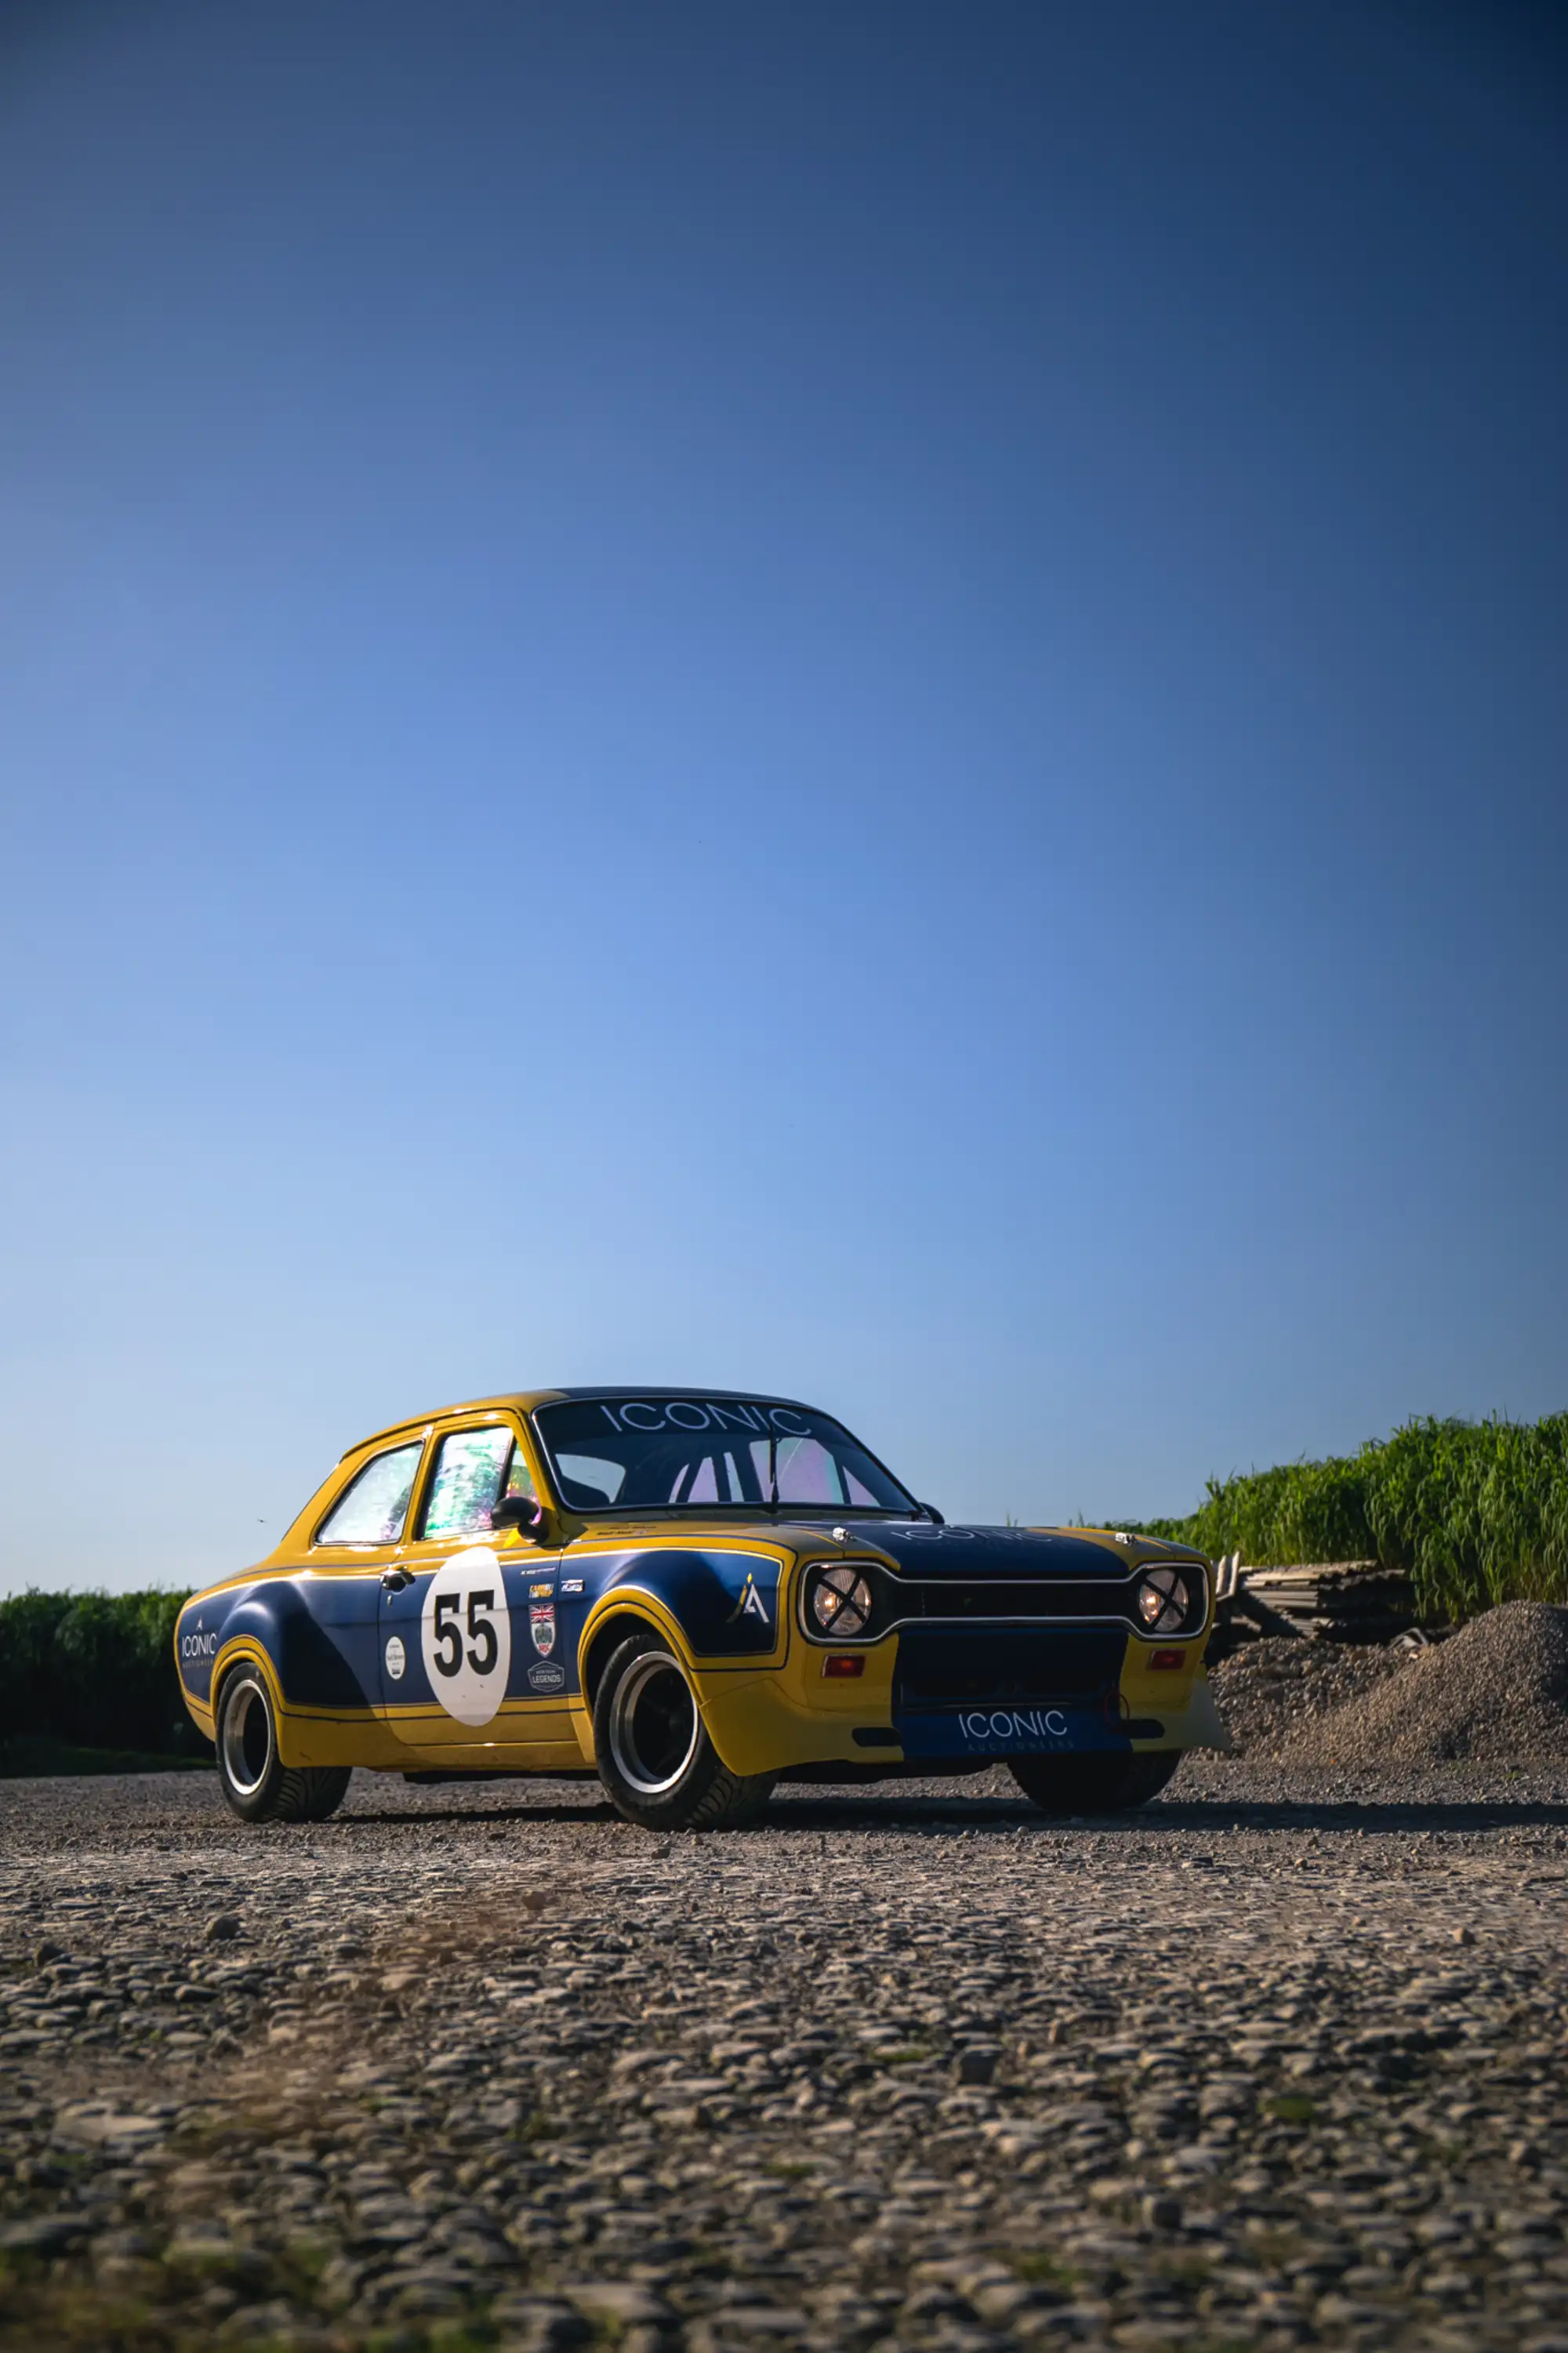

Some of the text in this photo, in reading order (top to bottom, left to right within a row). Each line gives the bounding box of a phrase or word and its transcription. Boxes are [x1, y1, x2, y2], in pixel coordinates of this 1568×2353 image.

[601, 1402, 812, 1436] ICONIC
[891, 1528, 1053, 1541] ICONIC
[182, 1632, 217, 1658] ICONIC
[433, 1589, 498, 1678] 55
[532, 1674, 561, 1683] LEGENDS
[958, 1709, 1068, 1738] ICONIC
[967, 1739, 1074, 1752] AUCTIONEERS
